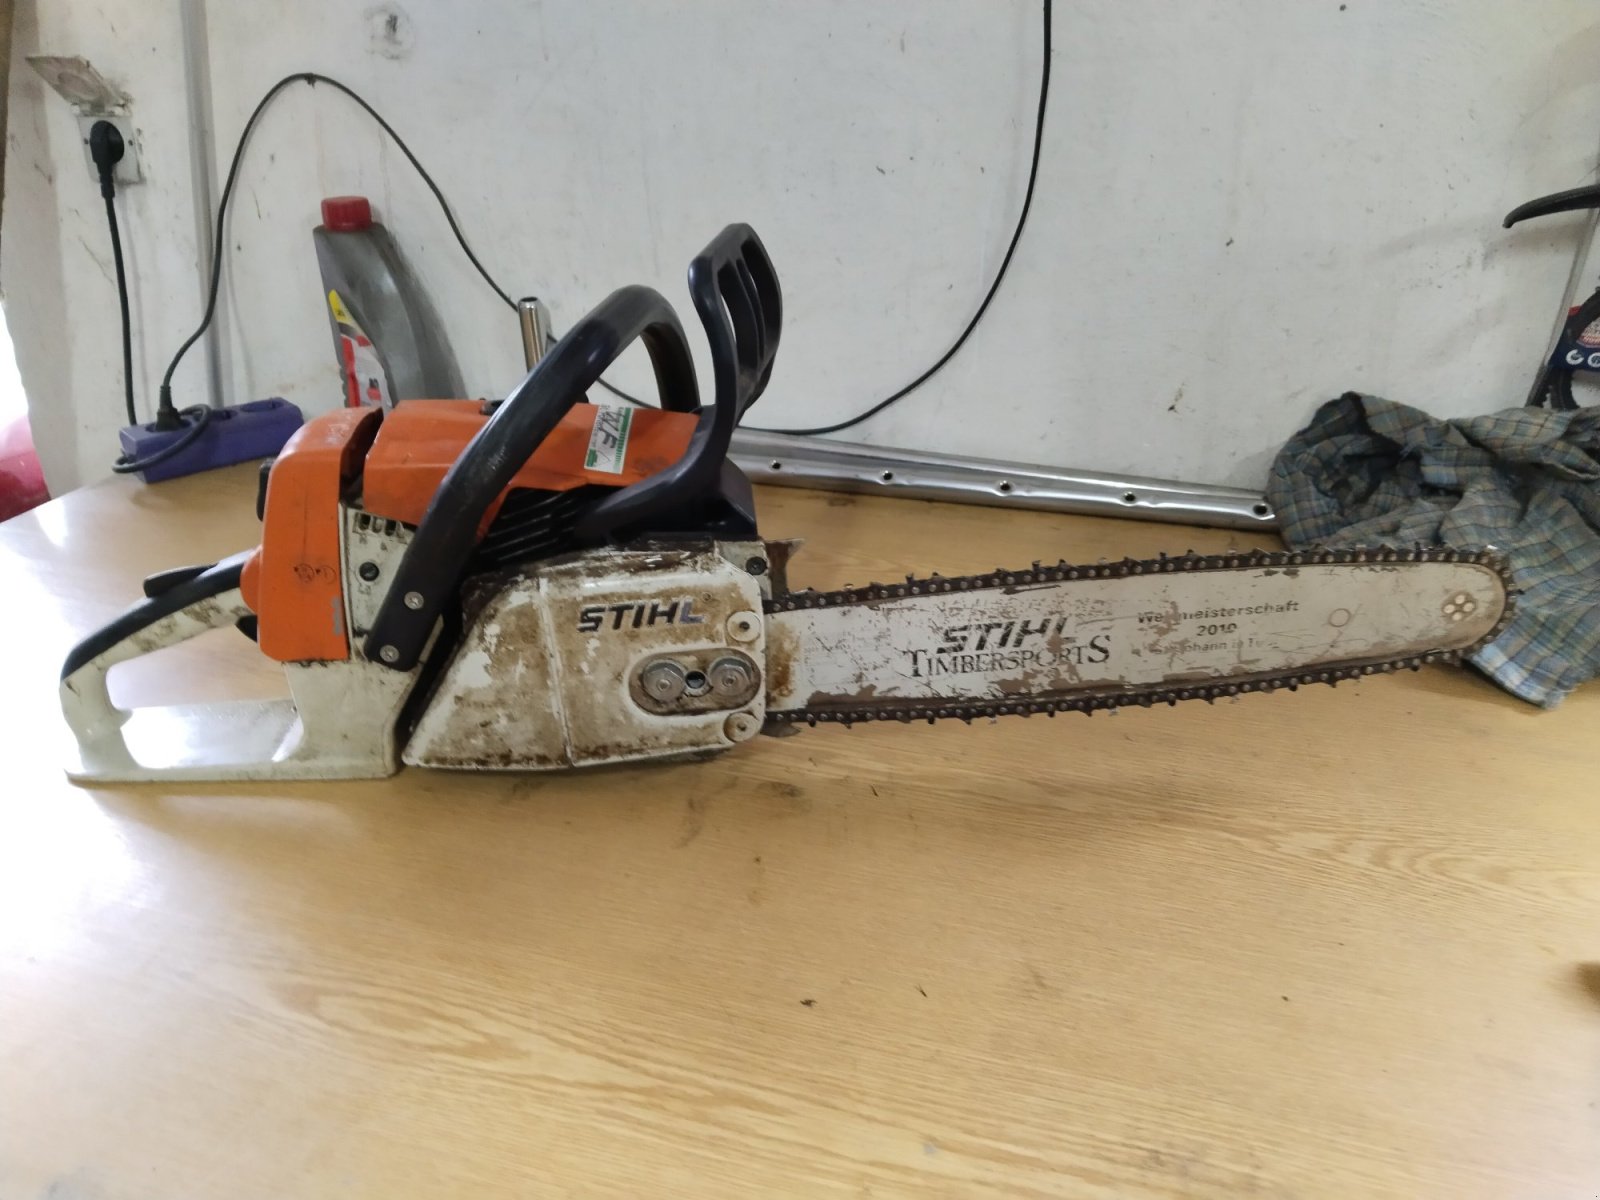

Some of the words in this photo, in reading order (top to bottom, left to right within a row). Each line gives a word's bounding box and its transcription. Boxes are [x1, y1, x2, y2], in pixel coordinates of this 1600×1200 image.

[577, 600, 705, 632] STIHL
[936, 617, 1078, 654] STIHL
[902, 634, 1111, 678] TIMBERSPORTS
